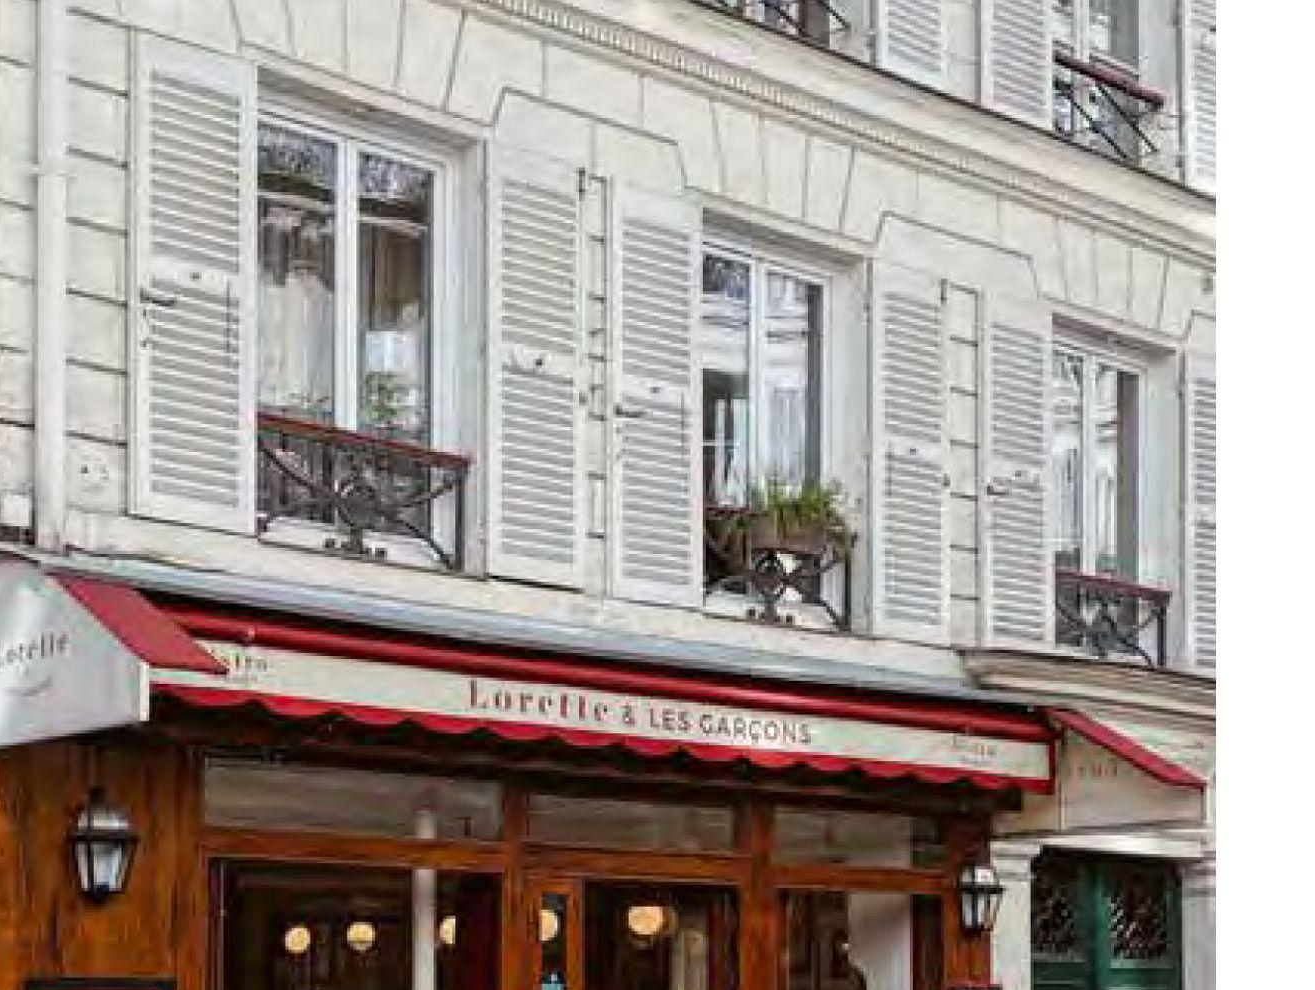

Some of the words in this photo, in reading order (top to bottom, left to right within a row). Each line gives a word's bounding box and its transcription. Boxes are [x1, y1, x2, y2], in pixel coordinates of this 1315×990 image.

[467, 679, 610, 723] Lorette
[648, 707, 692, 734] LES
[698, 712, 812, 746] GARÇONS
